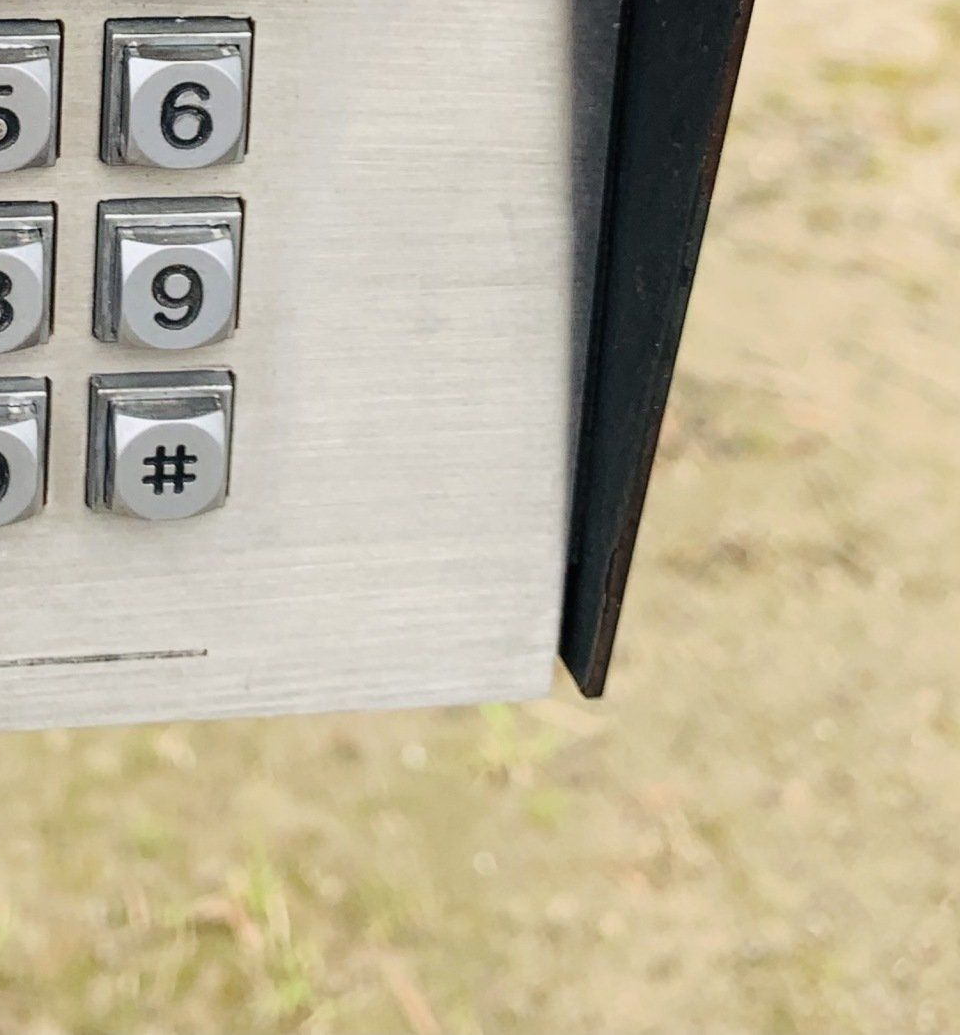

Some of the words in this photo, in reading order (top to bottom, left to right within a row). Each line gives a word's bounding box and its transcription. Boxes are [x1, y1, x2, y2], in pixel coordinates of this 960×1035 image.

[160, 82, 214, 149] 6
[152, 264, 204, 330] 9
[142, 445, 199, 496] #
